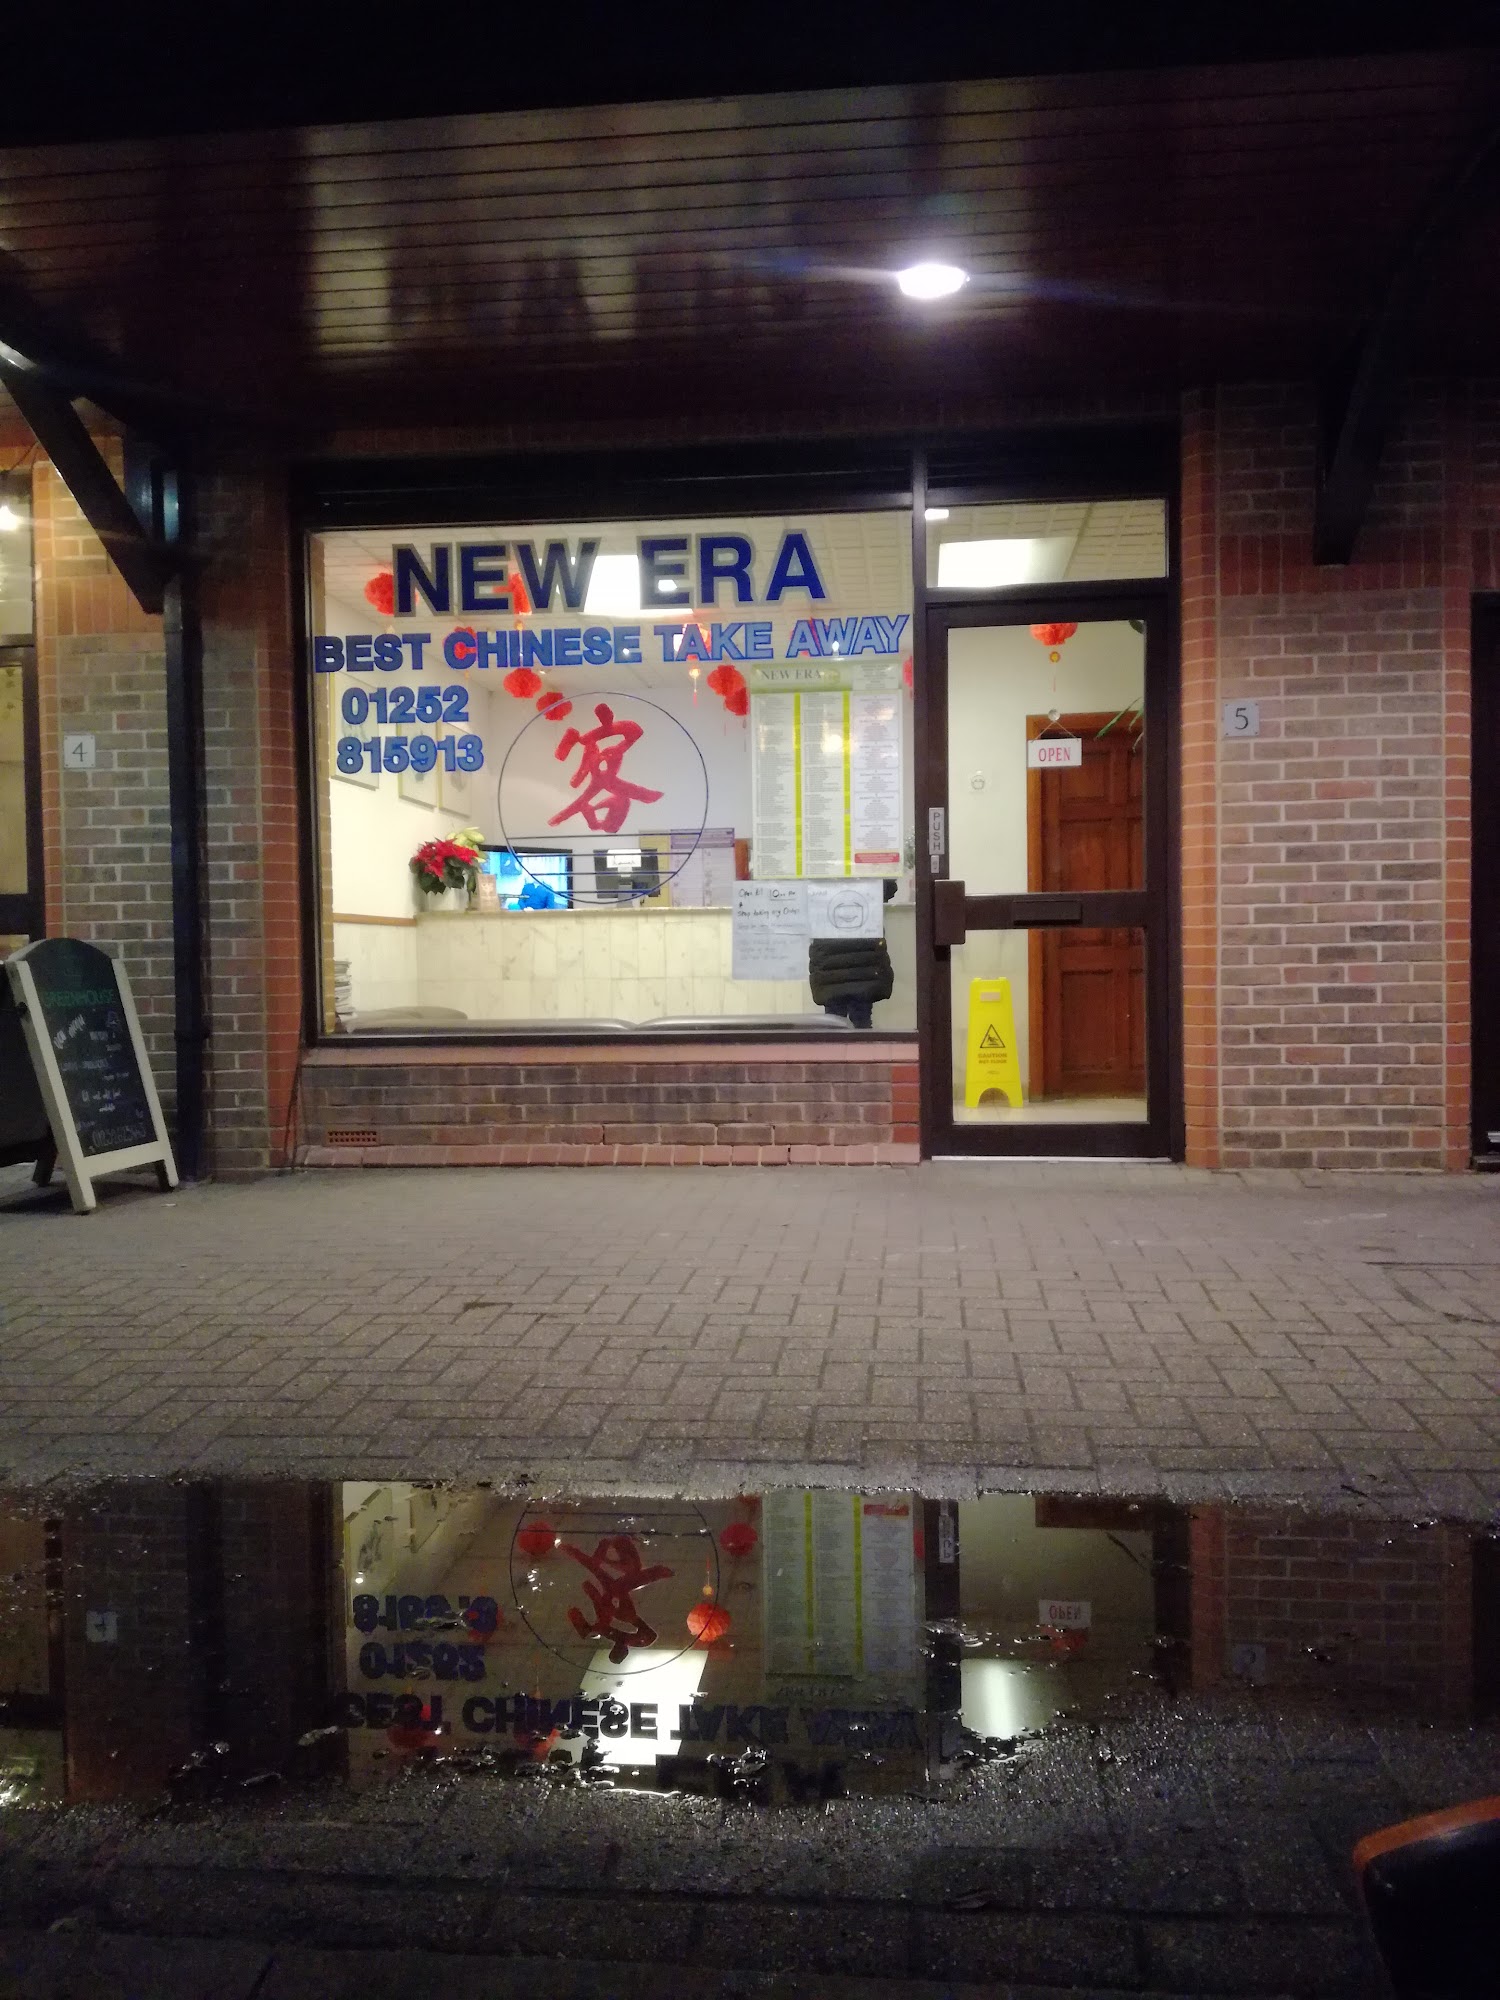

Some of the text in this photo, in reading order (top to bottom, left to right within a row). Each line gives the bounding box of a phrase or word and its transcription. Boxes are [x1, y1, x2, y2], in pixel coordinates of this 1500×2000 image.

[393, 528, 828, 617] NEW ERA
[314, 614, 909, 673] BEST CHINESE TAKE AWAY
[761, 669, 793, 680] NEW
[341, 685, 469, 725] 01252
[1234, 707, 1249, 731] 5
[72, 741, 88, 762] 4
[337, 735, 484, 774] 815913
[1038, 746, 1071, 762] OPEN
[933, 811, 941, 851] PUSH
